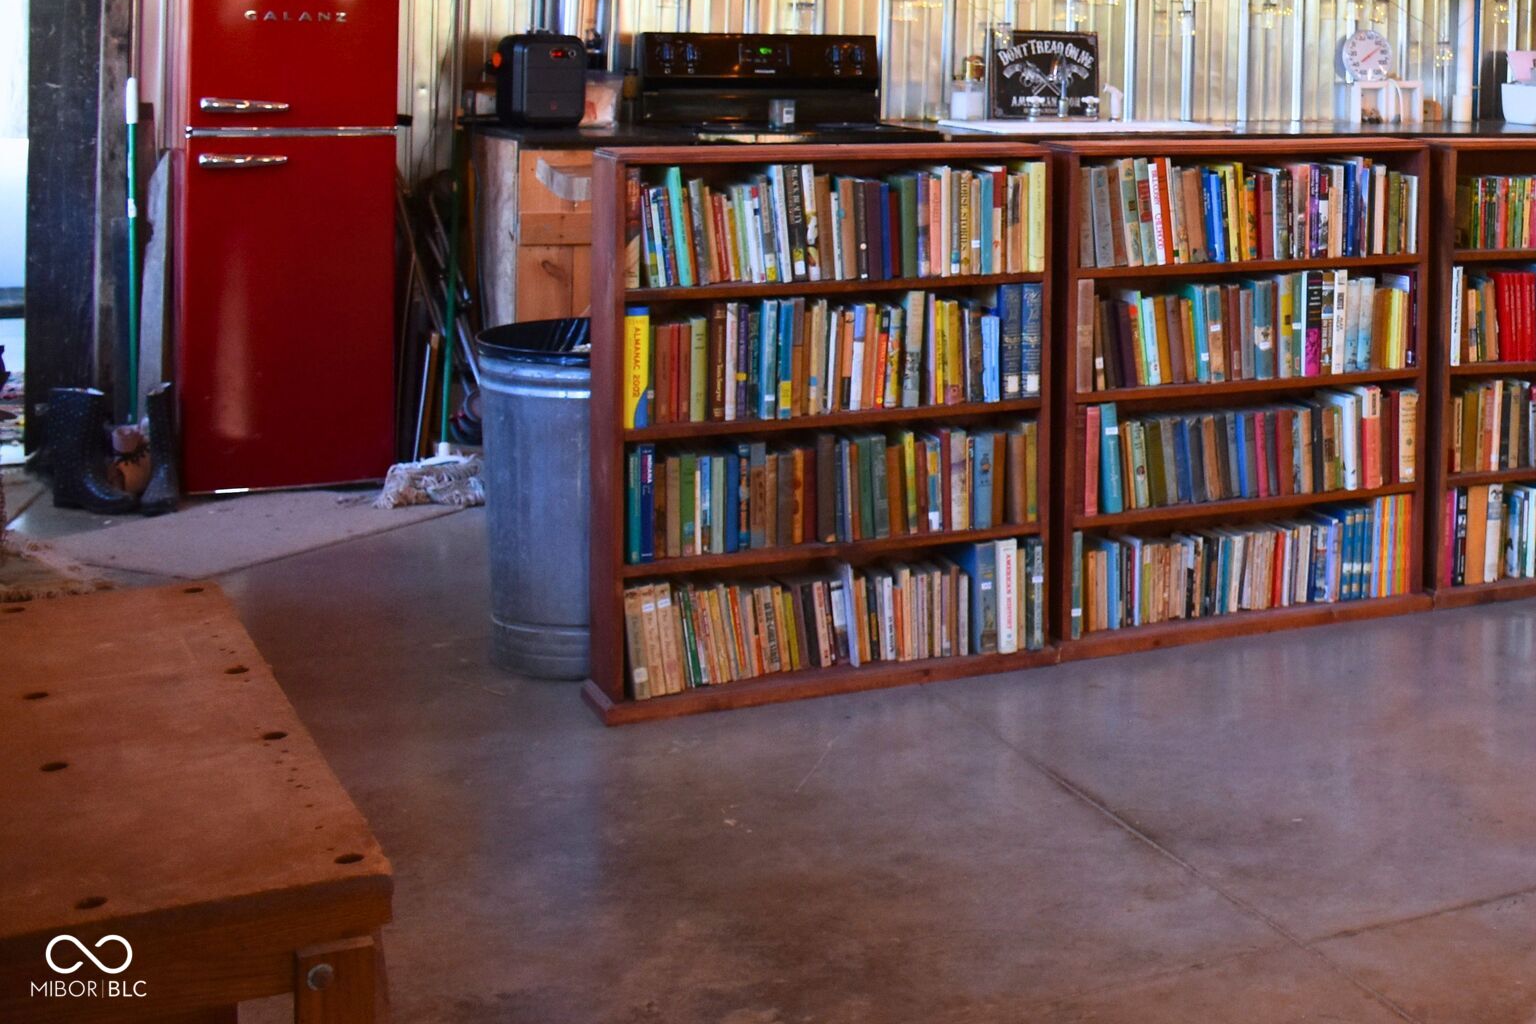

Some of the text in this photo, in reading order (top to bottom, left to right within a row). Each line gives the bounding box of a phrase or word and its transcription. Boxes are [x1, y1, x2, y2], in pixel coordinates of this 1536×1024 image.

[244, 10, 347, 22] GALANZ
[1028, 39, 1064, 56] TREAD
[632, 327, 641, 398] ALMANAC 2002
